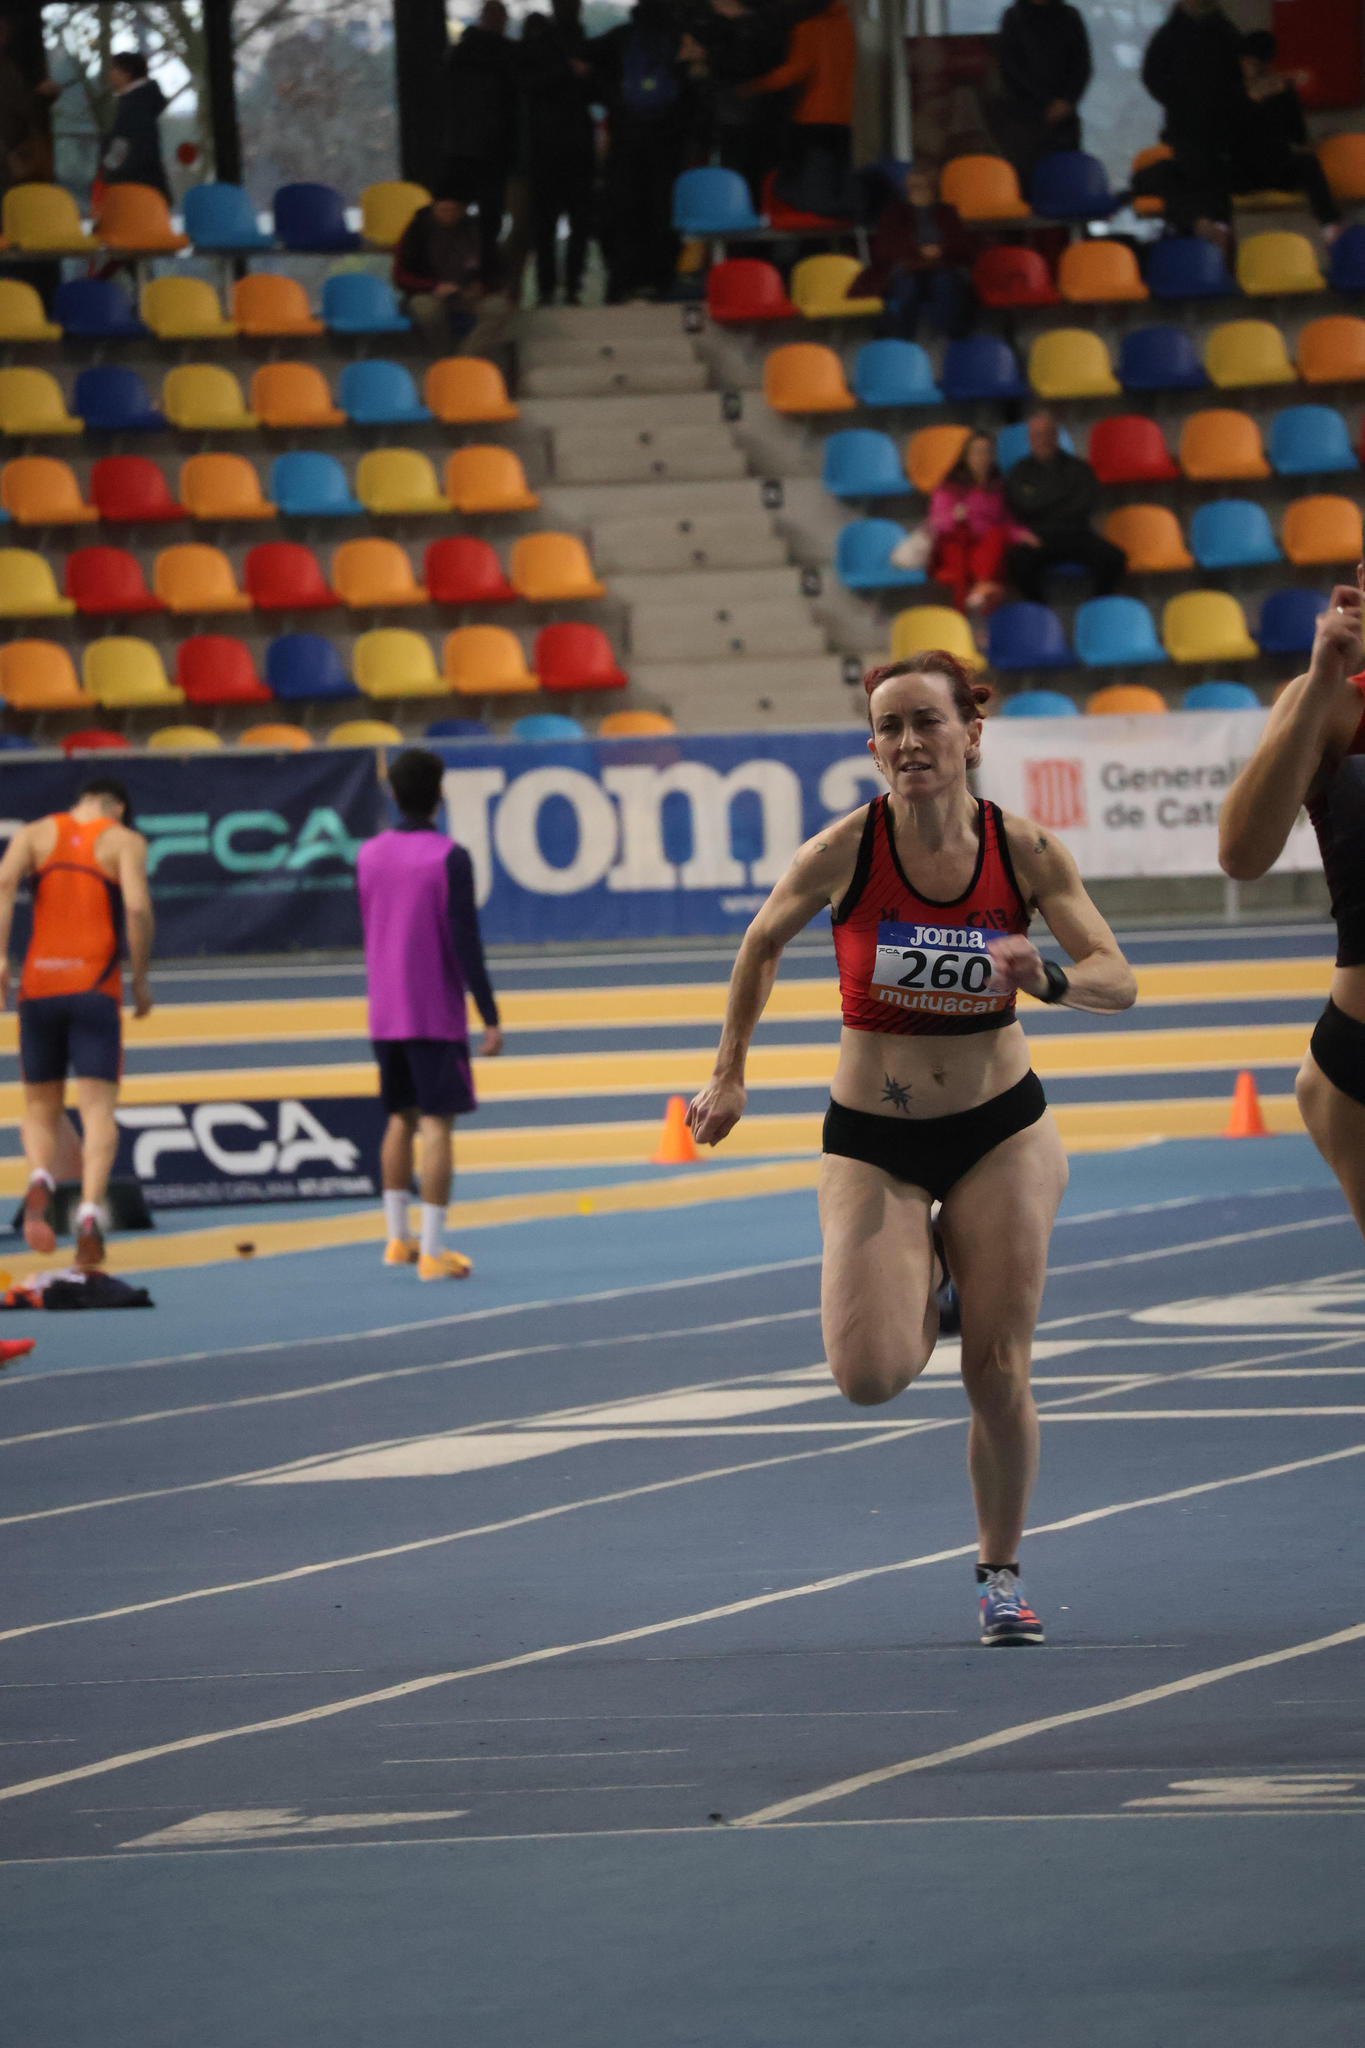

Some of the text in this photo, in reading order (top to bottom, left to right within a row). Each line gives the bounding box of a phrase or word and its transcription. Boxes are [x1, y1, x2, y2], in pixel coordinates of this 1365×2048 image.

[1101, 758, 1243, 792] General
[1104, 798, 1220, 828] de Cat
[135, 807, 360, 876] FCA
[897, 950, 992, 993] 260
[879, 989, 998, 1014] mutuacat
[114, 1099, 360, 1180] FCA
